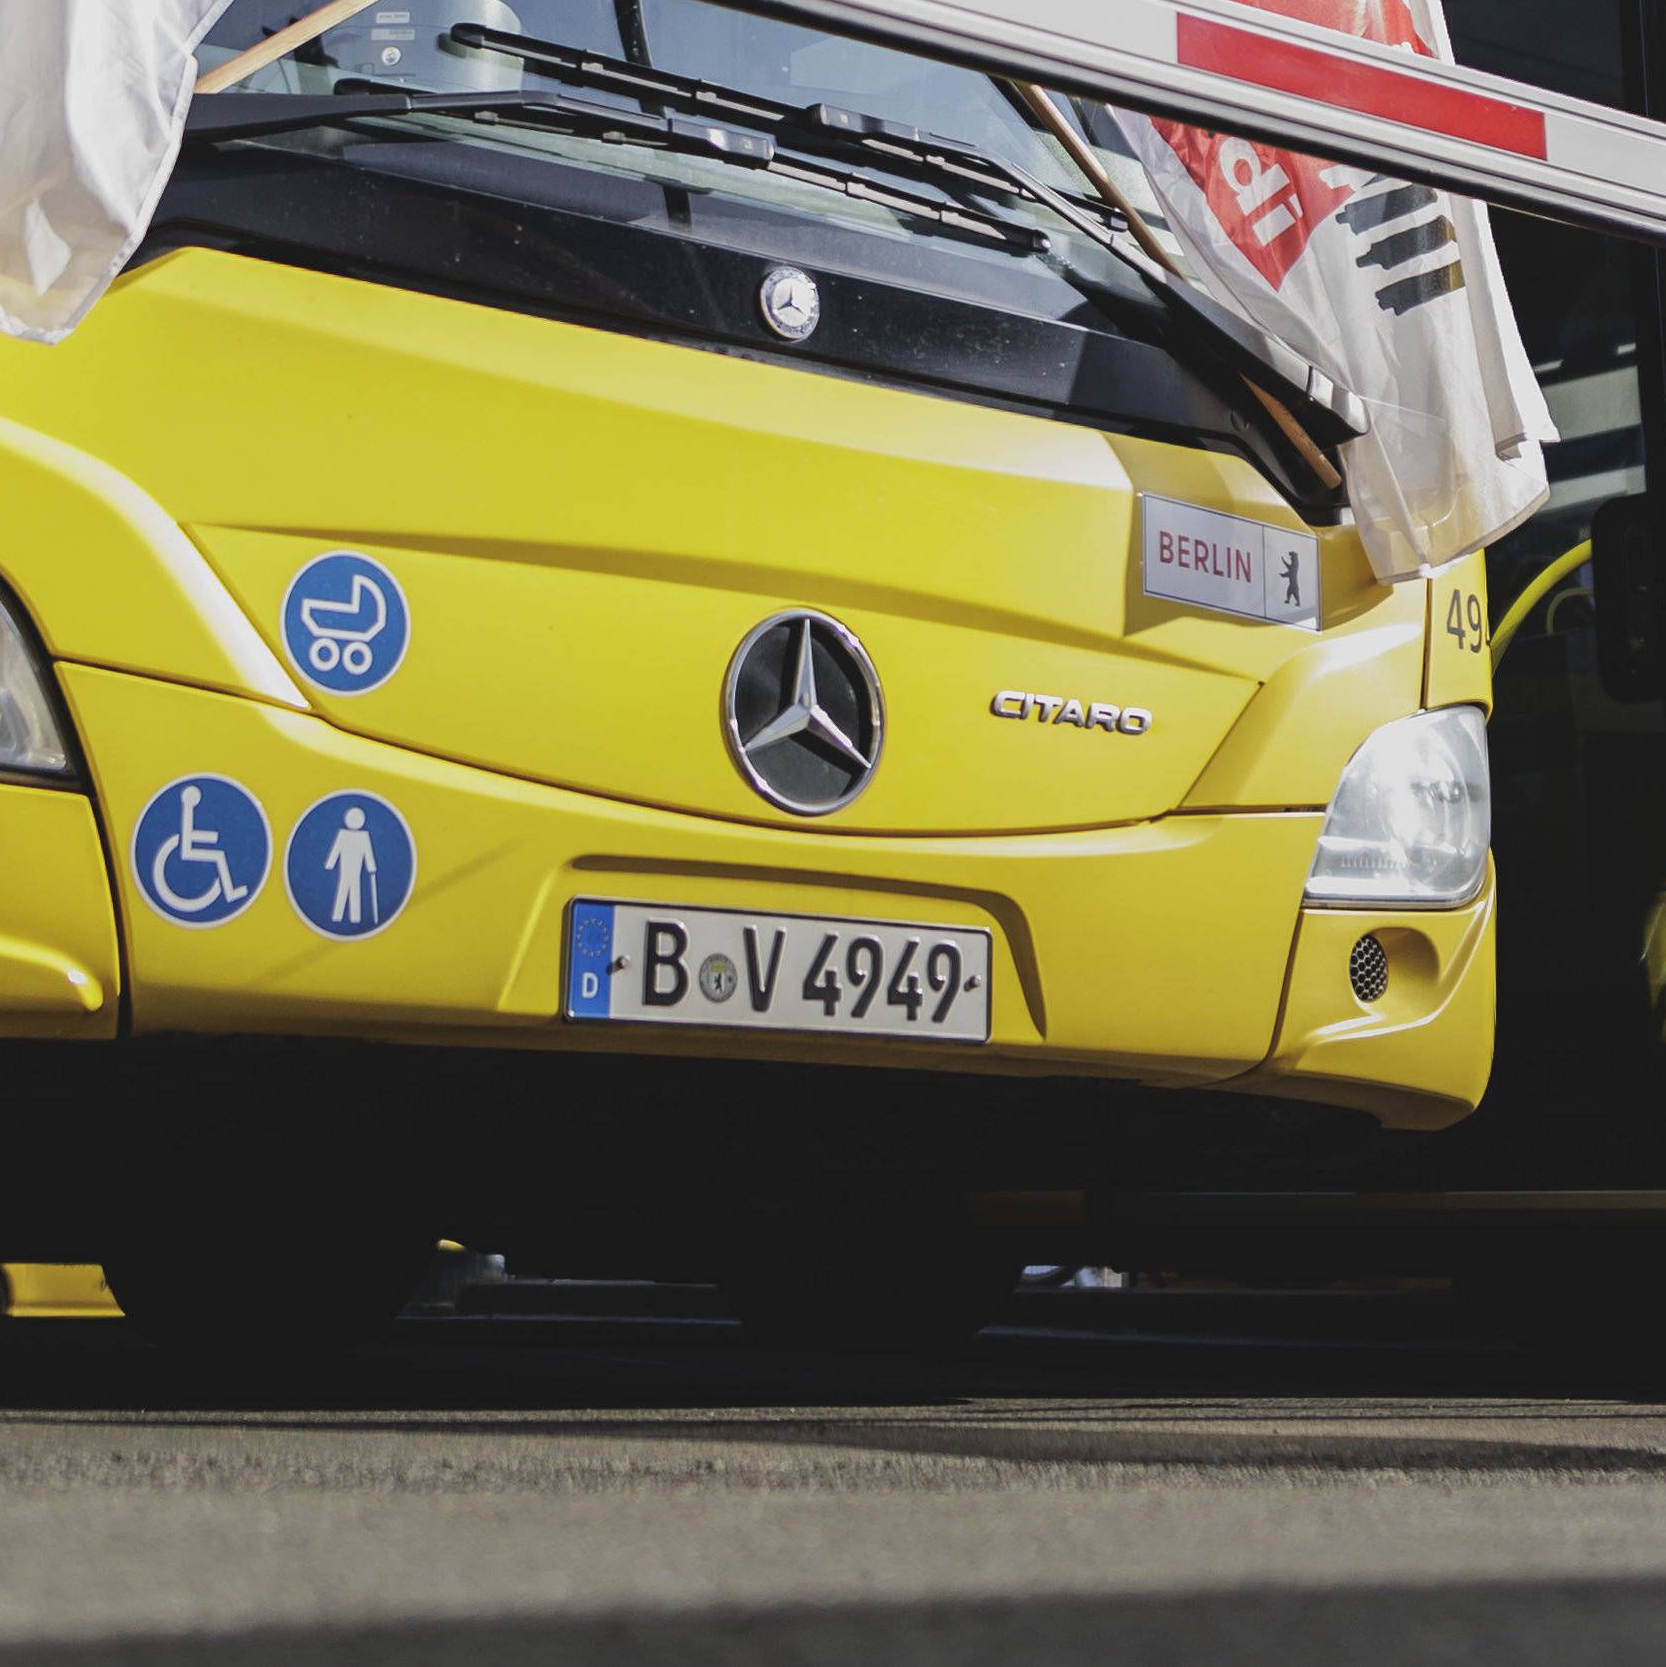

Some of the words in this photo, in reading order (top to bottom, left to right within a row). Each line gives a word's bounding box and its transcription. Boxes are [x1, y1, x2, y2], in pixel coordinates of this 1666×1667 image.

[1159, 530, 1252, 584] BERLIN
[1446, 588, 1490, 654] 49
[989, 689, 1153, 736] CITARO
[581, 972, 599, 999] D
[642, 920, 690, 1007] B
[743, 926, 786, 1012] V
[802, 933, 963, 1024] 4949
